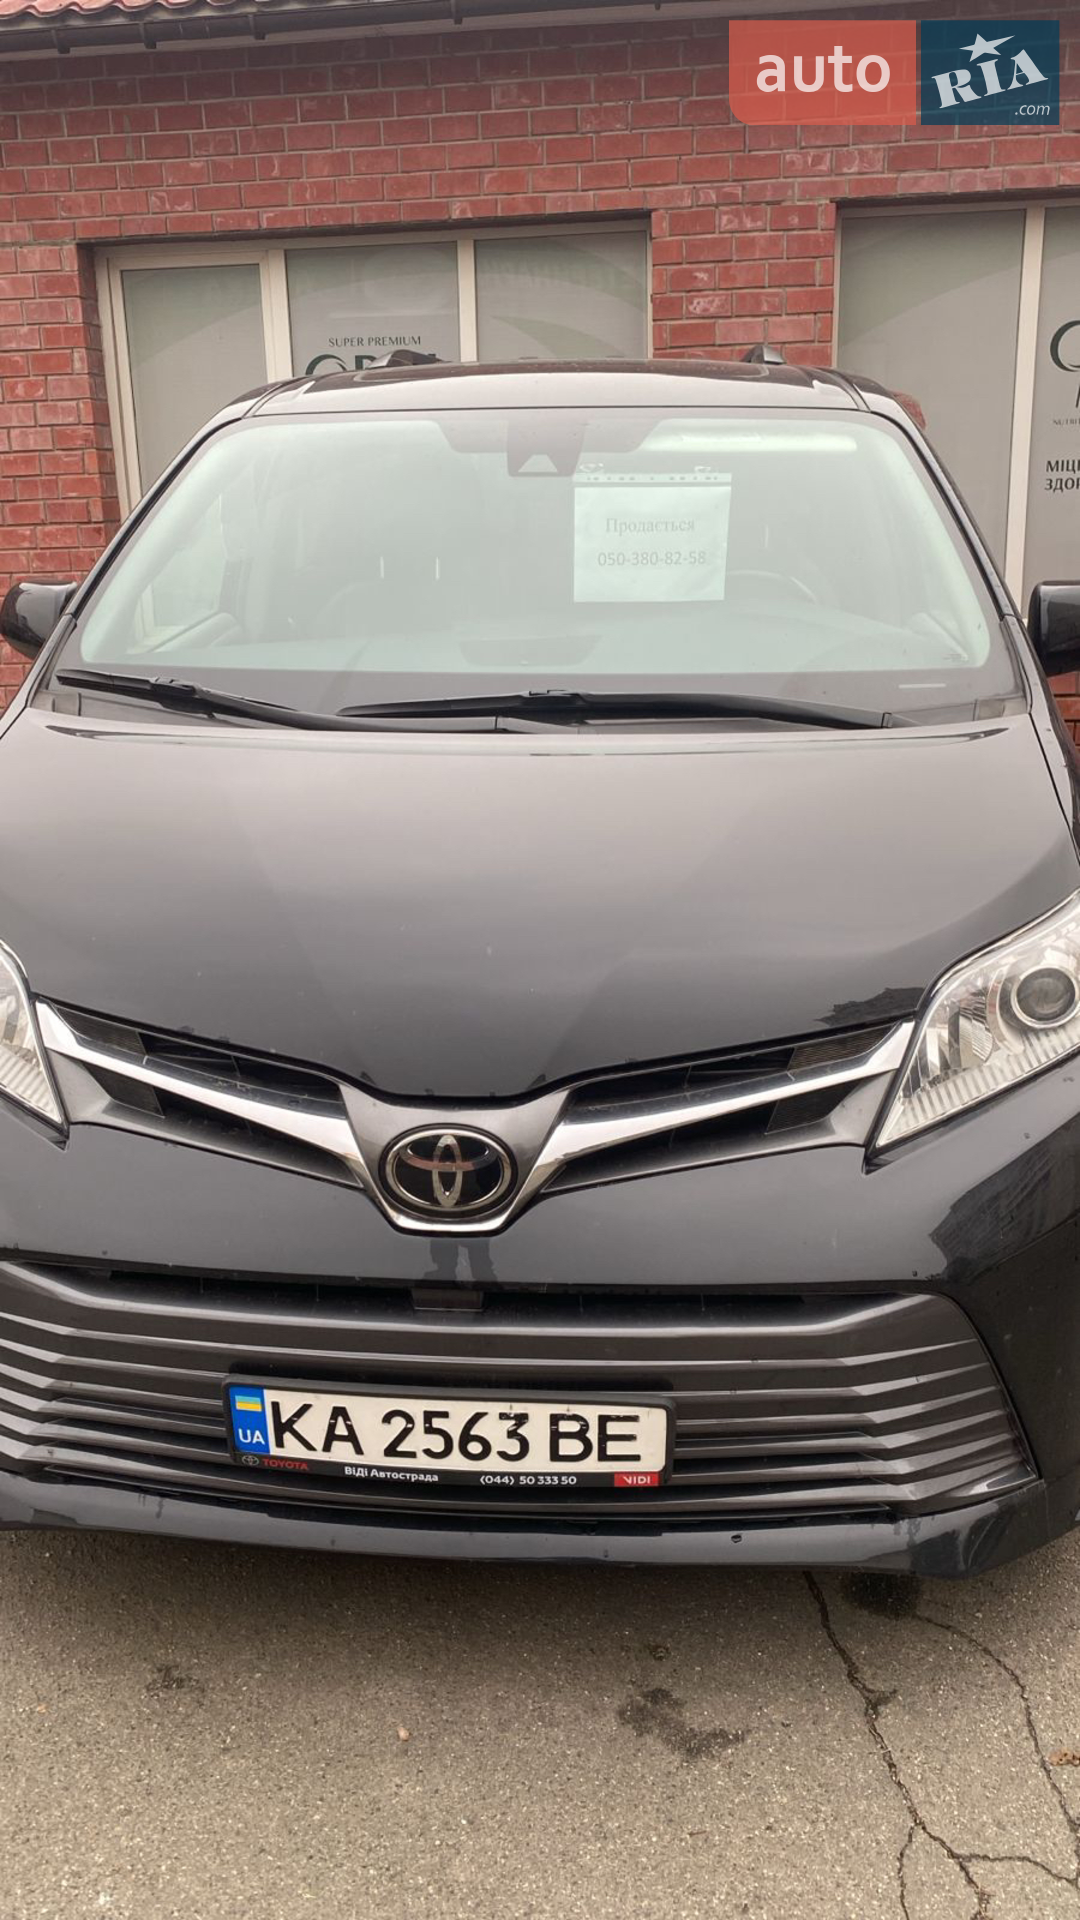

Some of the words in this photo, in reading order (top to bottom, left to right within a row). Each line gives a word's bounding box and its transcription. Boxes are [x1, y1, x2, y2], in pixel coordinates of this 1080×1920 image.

[328, 336, 365, 348] SUPER
[367, 335, 421, 347] PREMIUM
[605, 517, 695, 536] Продається
[597, 550, 707, 567] 050-380-82-58
[238, 1428, 265, 1445] UA
[271, 1401, 364, 1455] KA
[381, 1409, 530, 1462] 2563
[549, 1412, 641, 1462] BE
[262, 1458, 309, 1471] TOYOTA
[370, 1468, 439, 1482] Автострада
[480, 1475, 515, 1485] (044)
[519, 1475, 535, 1485] 50
[537, 1475, 559, 1485] 333
[561, 1475, 577, 1485] 50
[622, 1476, 651, 1484] VIDI
